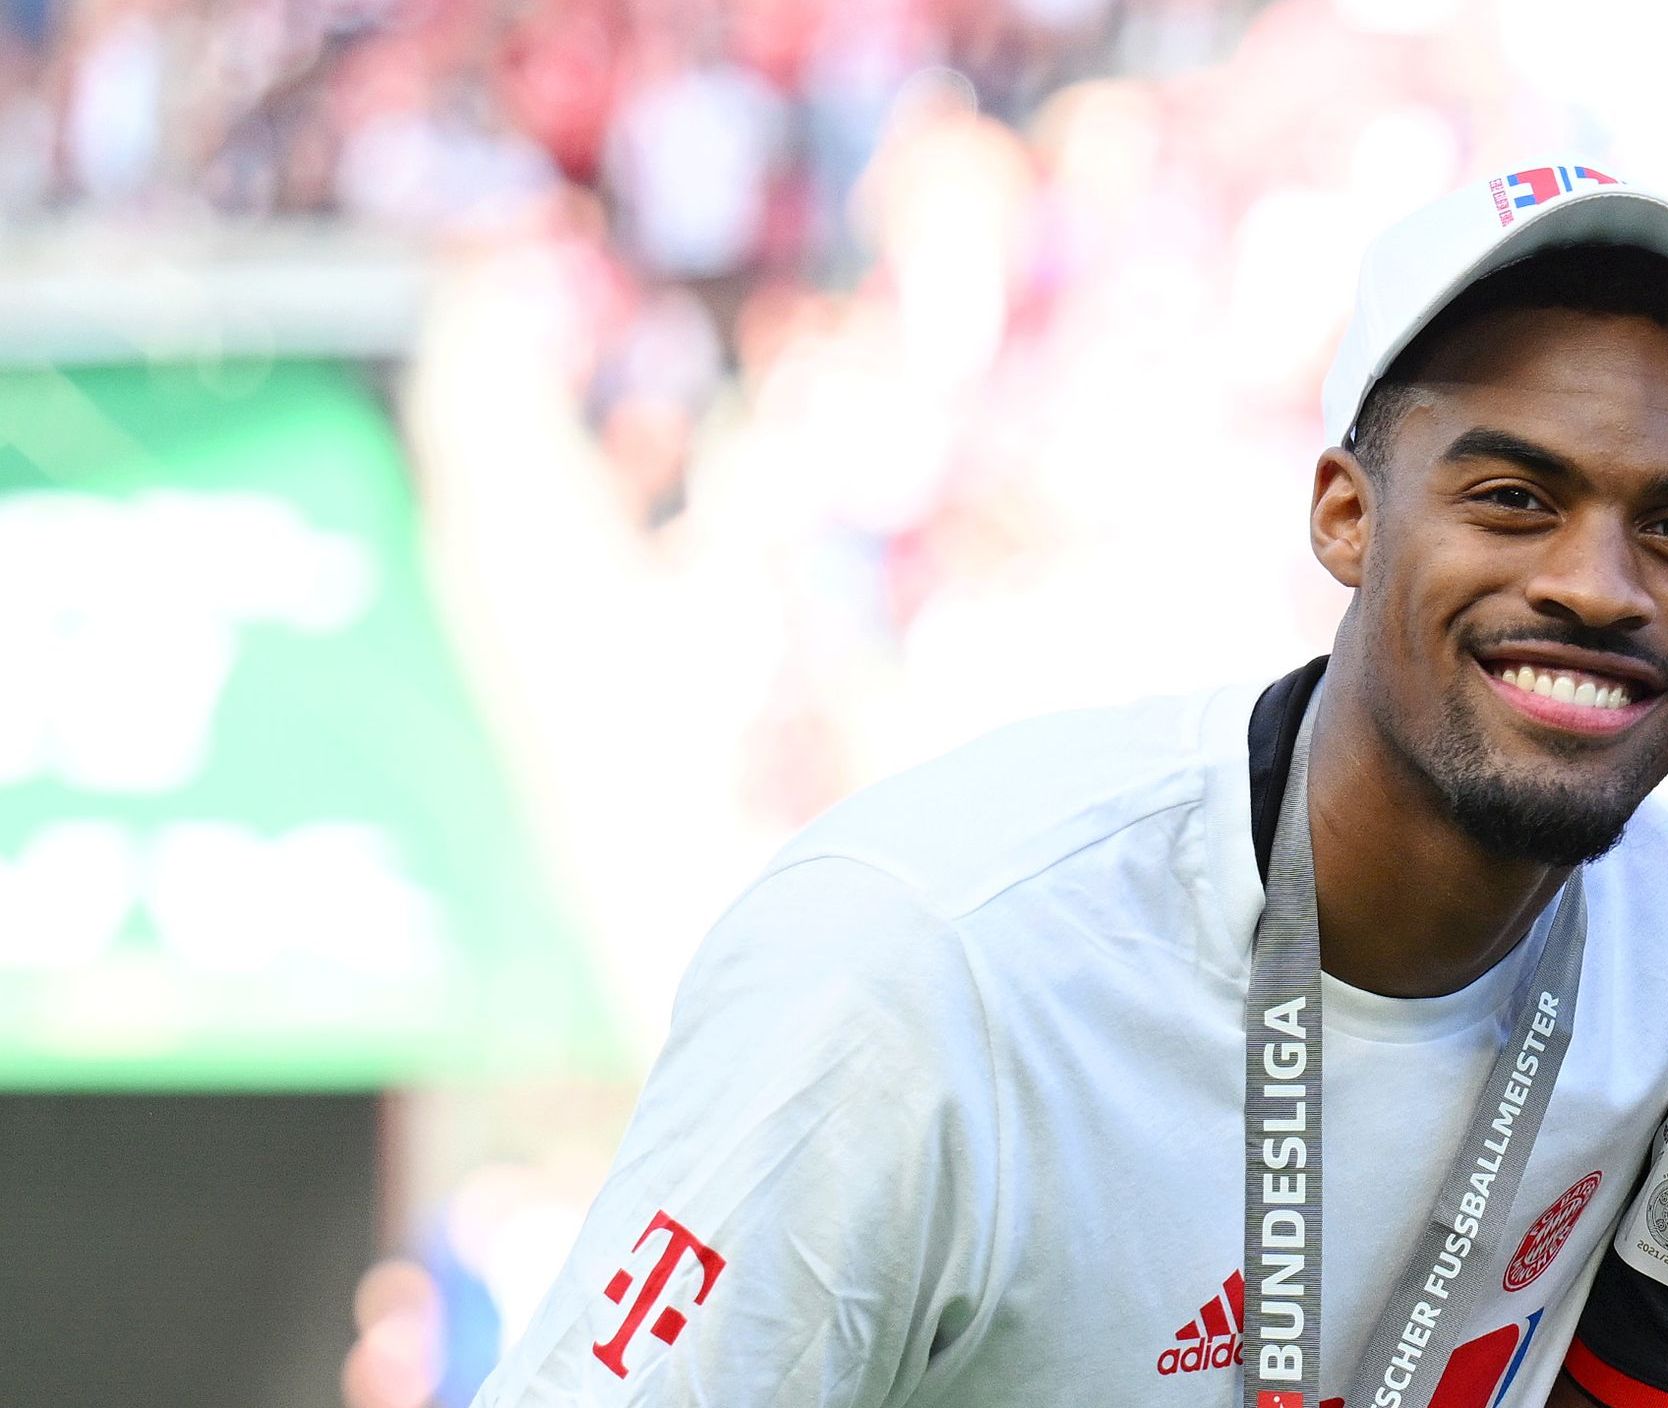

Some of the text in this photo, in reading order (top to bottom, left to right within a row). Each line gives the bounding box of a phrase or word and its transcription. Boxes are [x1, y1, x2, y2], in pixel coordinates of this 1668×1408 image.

[1259, 996, 1307, 1382] BUNDESLIGA
[1425, 991, 1560, 1303] FUSSBALLMEISTER
[1157, 1333, 1243, 1375] adid
